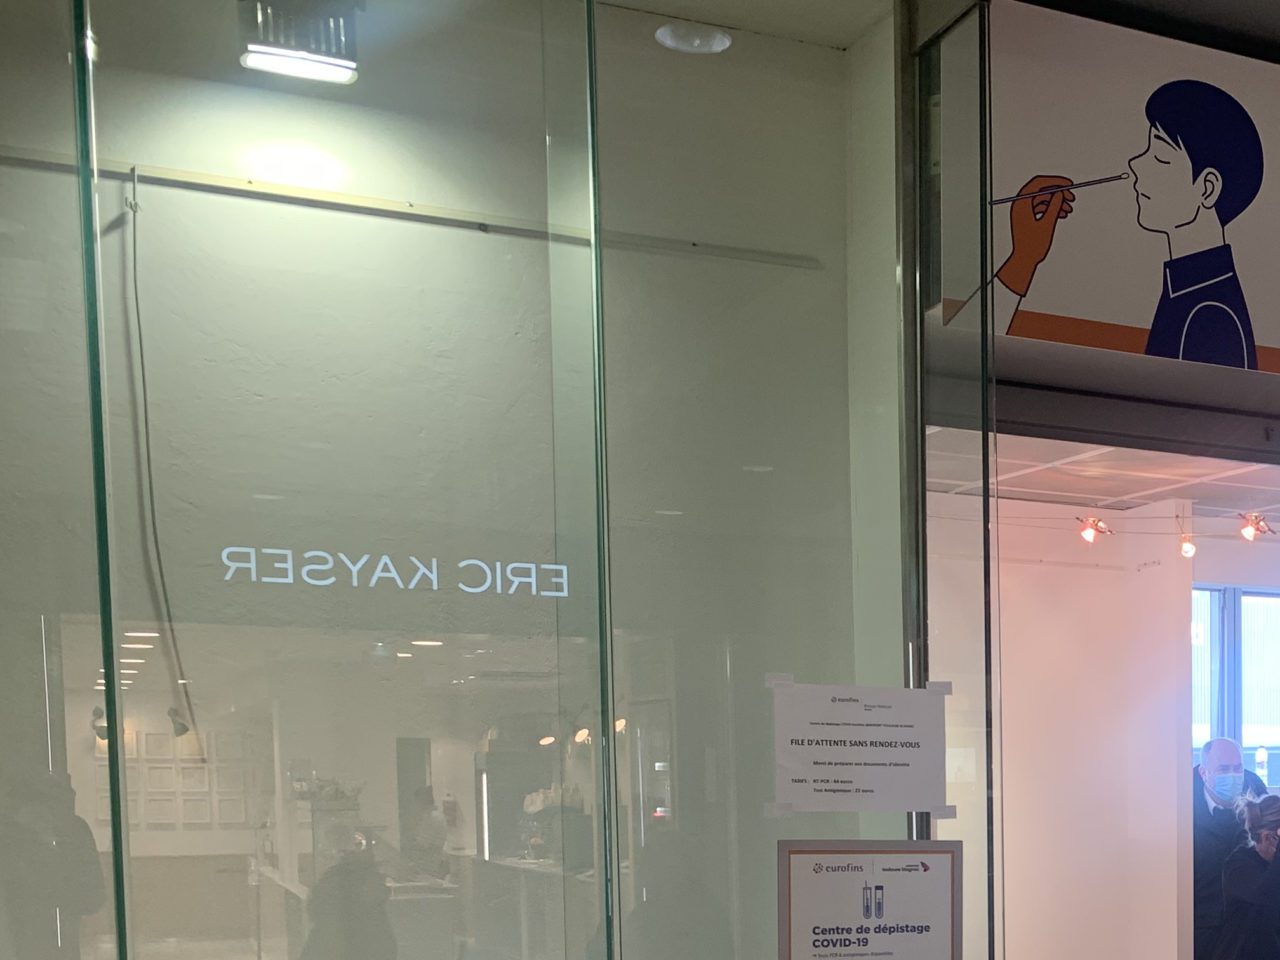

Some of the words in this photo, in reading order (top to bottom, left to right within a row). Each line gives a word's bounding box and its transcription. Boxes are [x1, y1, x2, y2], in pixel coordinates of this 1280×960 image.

[790, 738, 805, 746] FILE
[807, 739, 848, 748] D'ATTENTE
[849, 740, 868, 748] SANS
[869, 740, 921, 749] RENDEZ-VOUS
[825, 863, 864, 872] eurofins
[812, 926, 853, 935] Centre
[856, 925, 870, 934] de
[874, 924, 931, 935] dépistage
[812, 938, 869, 948] COVID-19
